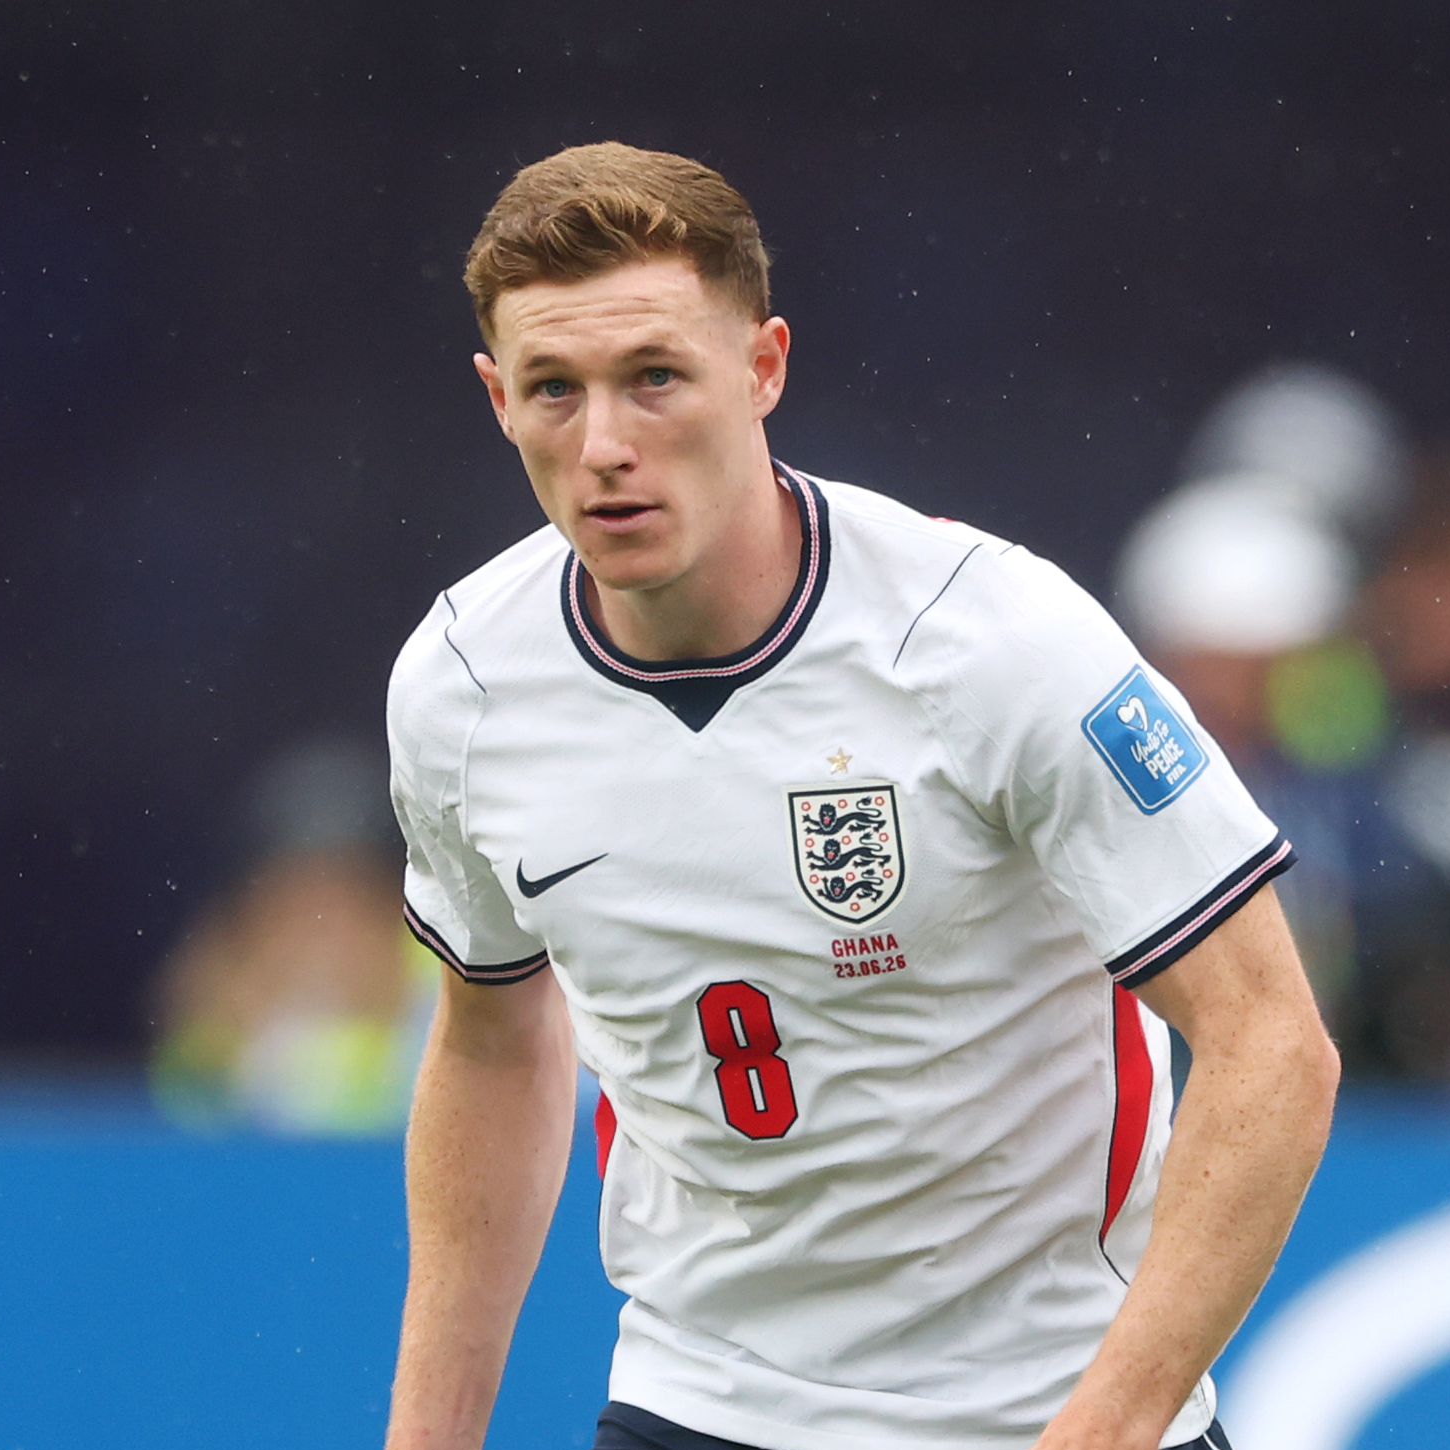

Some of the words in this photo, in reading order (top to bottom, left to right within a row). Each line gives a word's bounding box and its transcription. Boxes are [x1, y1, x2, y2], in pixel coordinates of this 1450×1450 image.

[1145, 737, 1184, 780] PEACE
[1165, 763, 1187, 785] FIFA
[831, 933, 899, 958] GHANA
[834, 954, 906, 979] 23.06.26
[696, 979, 799, 1141] 8
